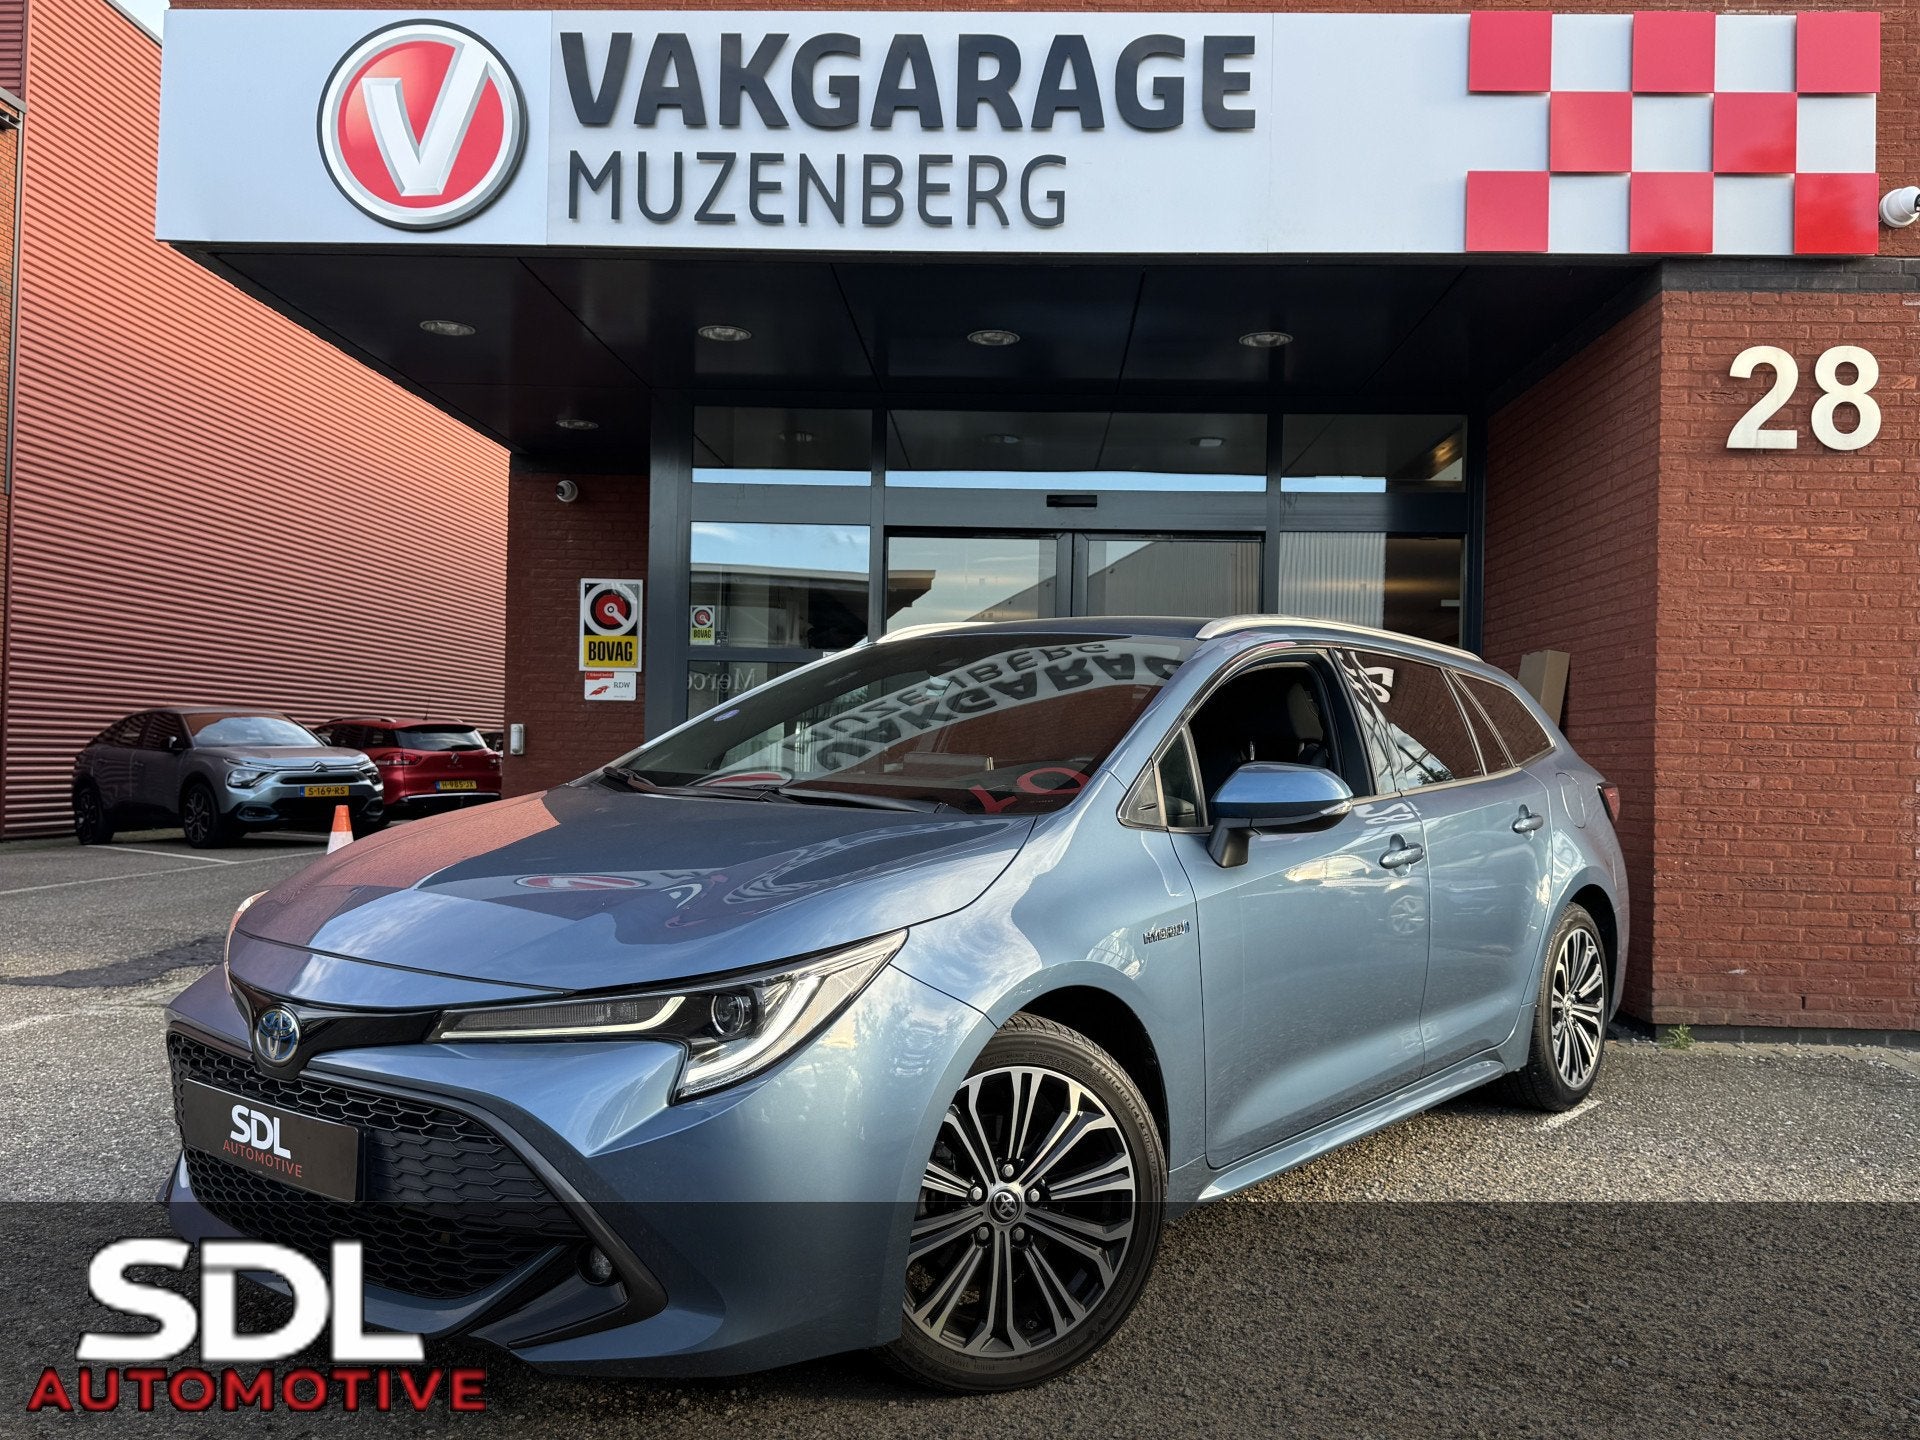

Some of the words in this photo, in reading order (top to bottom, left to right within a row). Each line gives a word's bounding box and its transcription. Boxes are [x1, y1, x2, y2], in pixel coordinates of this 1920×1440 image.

[559, 32, 1256, 132] VAKGARAGE
[568, 149, 1068, 228] MUZENBERG
[1726, 345, 1882, 451] 28
[693, 629, 712, 639] BOVAG
[588, 640, 633, 661] BOVAG
[613, 681, 631, 689] RDW
[307, 786, 346, 796] S-169-RS
[1142, 919, 1190, 945] HYBRID
[230, 1104, 292, 1159] SDL
[223, 1139, 303, 1178] AUTOMOTIVE
